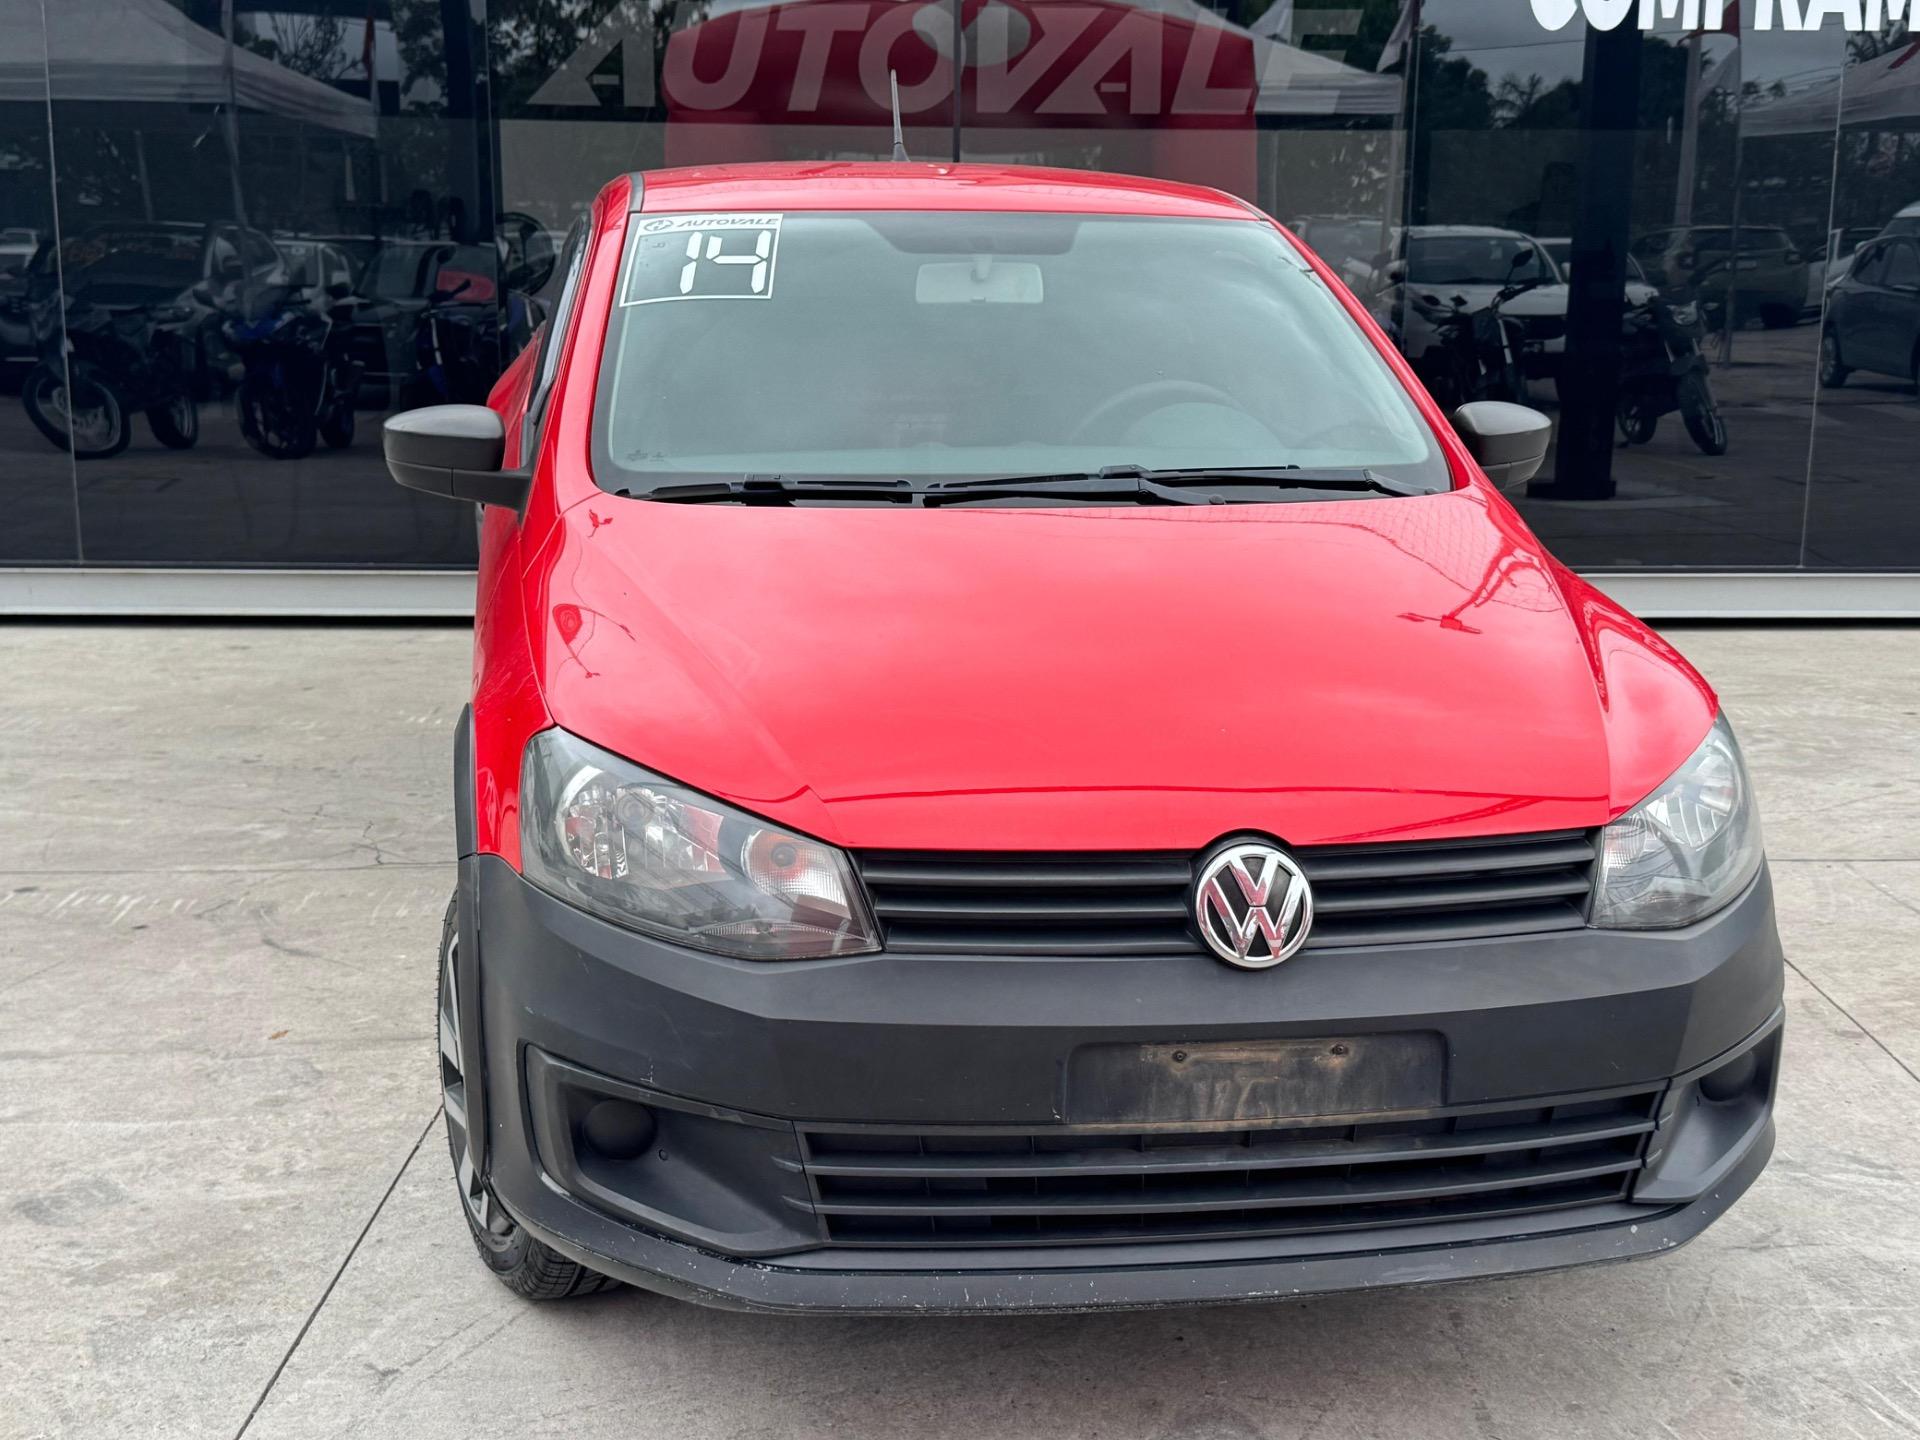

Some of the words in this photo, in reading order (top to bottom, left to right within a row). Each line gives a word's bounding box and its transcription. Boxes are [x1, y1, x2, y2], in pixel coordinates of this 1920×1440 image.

[526, 1, 1364, 114] AUTOVALE
[676, 218, 779, 228] AUTOVALE
[679, 230, 772, 294] 14
